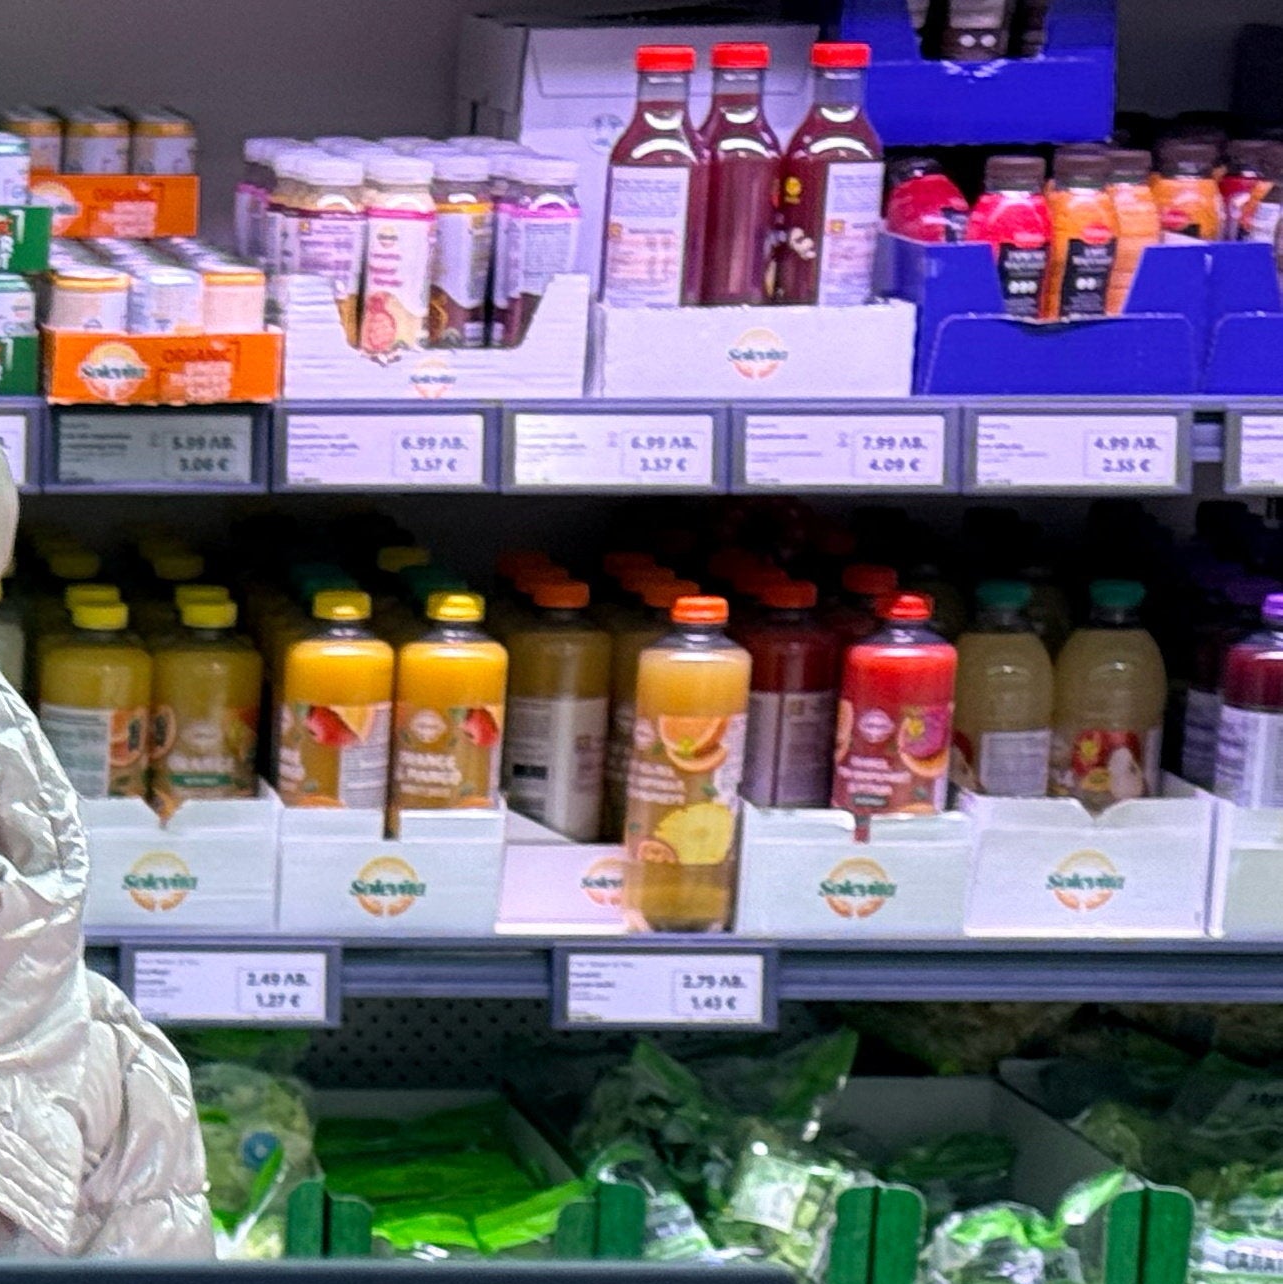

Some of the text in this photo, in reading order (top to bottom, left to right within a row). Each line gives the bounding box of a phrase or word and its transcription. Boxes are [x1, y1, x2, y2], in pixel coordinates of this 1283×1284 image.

[122, 872, 199, 891] Solevita
[350, 879, 426, 899] Solevita
[819, 879, 896, 898] Solevita
[1046, 873, 1126, 891] Solevita
[289, 993, 300, 1008] €
[725, 995, 737, 1010] €
